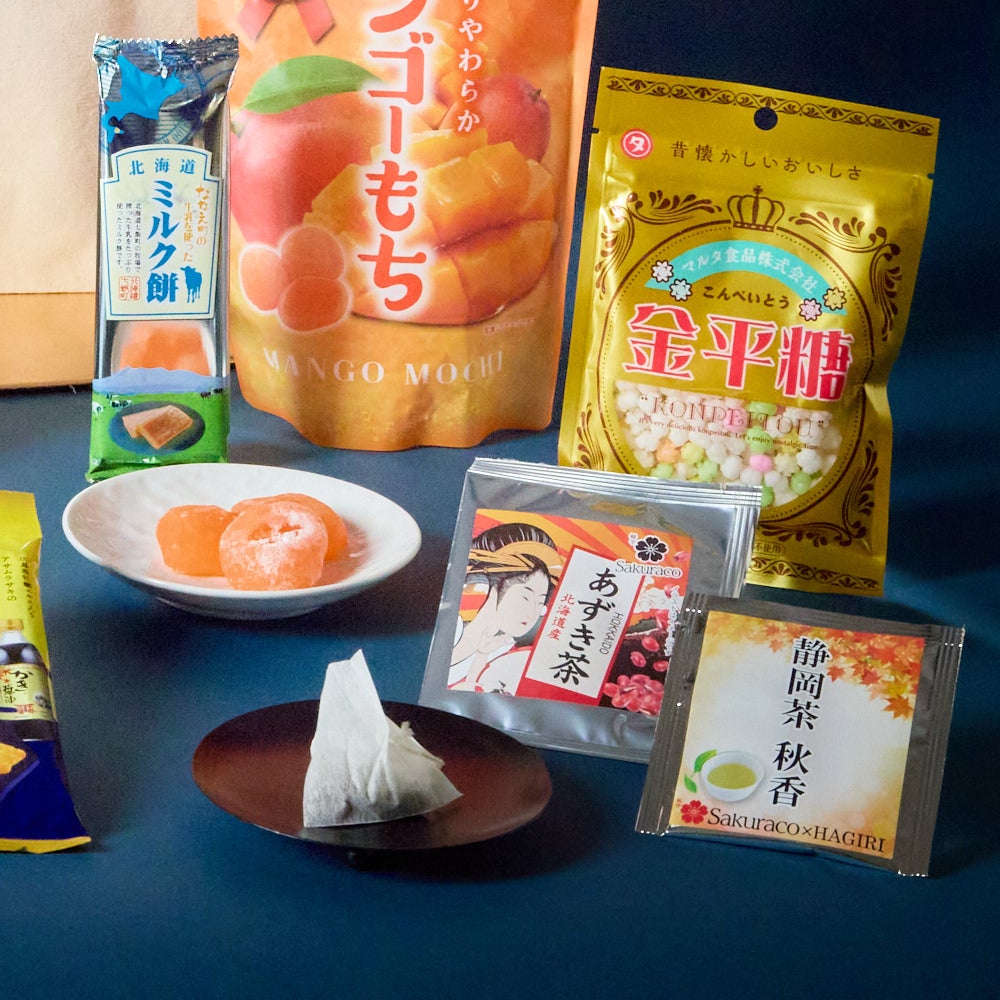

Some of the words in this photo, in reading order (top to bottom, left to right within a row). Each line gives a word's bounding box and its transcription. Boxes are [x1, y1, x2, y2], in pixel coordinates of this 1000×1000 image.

[129, 158, 196, 175] 北海道
[670, 140, 862, 180] 昔懐かしいおいしさ
[146, 180, 180, 303] ミルク餅
[682, 247, 818, 294] マルタ食品株式会社
[262, 346, 385, 383] MANGO
[404, 350, 503, 385] MOCHI
[623, 302, 855, 402] 金平糖
[751, 433, 771, 444] enjoy
[614, 560, 682, 578] Sakuraco
[546, 593, 575, 641] 北海道産
[550, 568, 619, 685] あずき茶
[599, 612, 622, 655] HOKKAIDO
[781, 637, 832, 731] 静岡茶
[767, 740, 814, 808] 秋香
